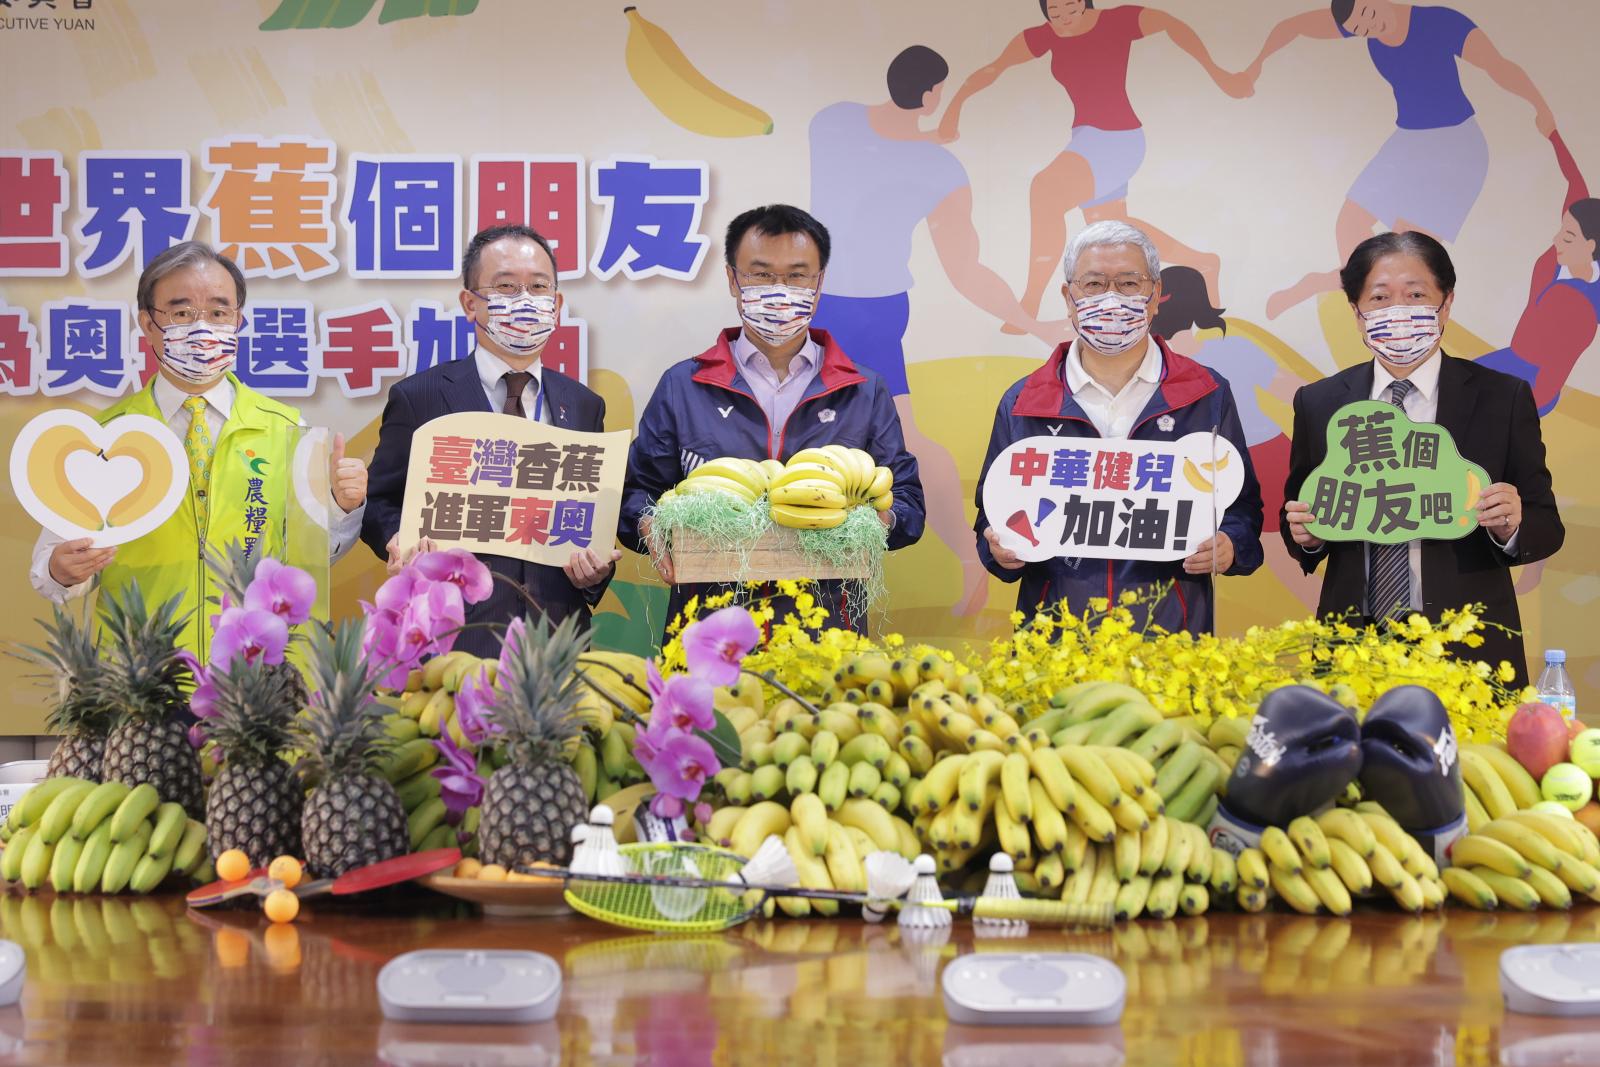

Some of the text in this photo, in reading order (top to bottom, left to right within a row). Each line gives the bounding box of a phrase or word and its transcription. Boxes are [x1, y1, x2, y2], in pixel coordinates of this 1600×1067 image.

[53, 18, 95, 30] YUAN
[0, 142, 703, 274] 世界蕉個朋友
[0, 305, 580, 390] 奧選手加
[426, 435, 605, 493] 臺灣香蕉
[1010, 447, 1175, 492] 中華健兒
[1337, 410, 1440, 477] 蕉個
[418, 491, 597, 548] 進軍東奧
[1060, 494, 1193, 551] 加油!
[1311, 476, 1454, 535] 朋友吧
